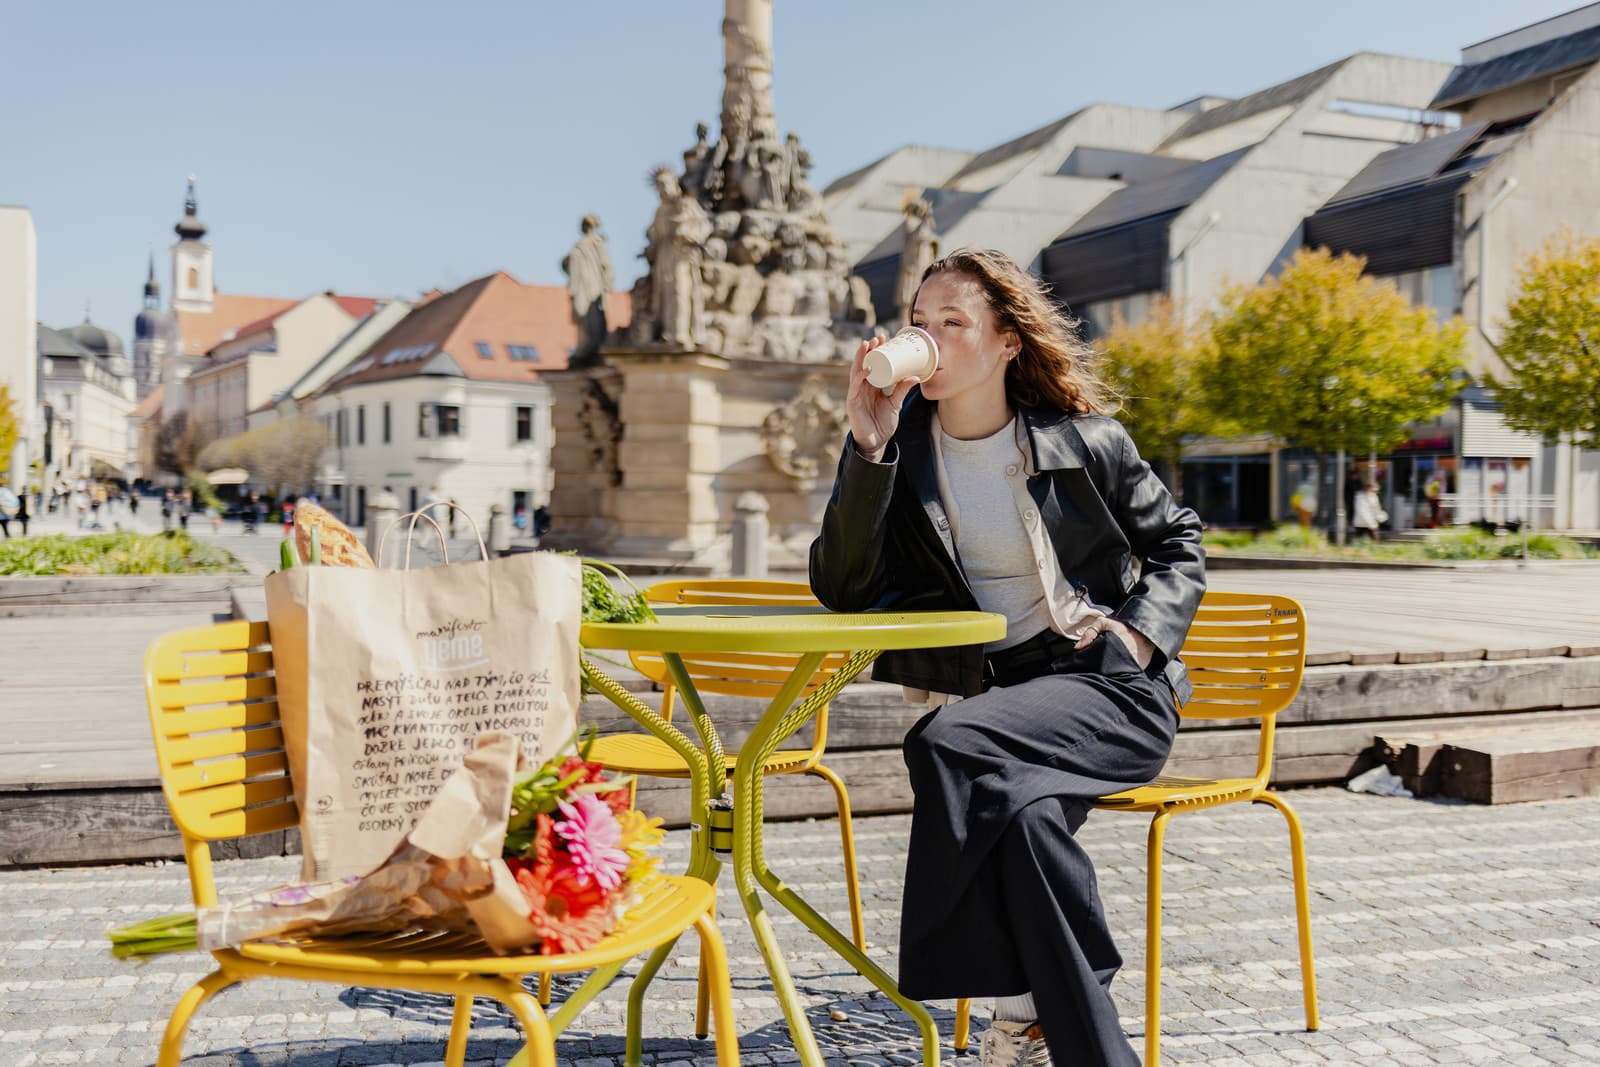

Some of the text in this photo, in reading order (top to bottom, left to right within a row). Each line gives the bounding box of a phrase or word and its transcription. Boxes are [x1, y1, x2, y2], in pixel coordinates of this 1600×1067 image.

[416, 618, 488, 641] manifesto
[423, 633, 484, 672] yeme
[444, 676, 470, 691] NAD
